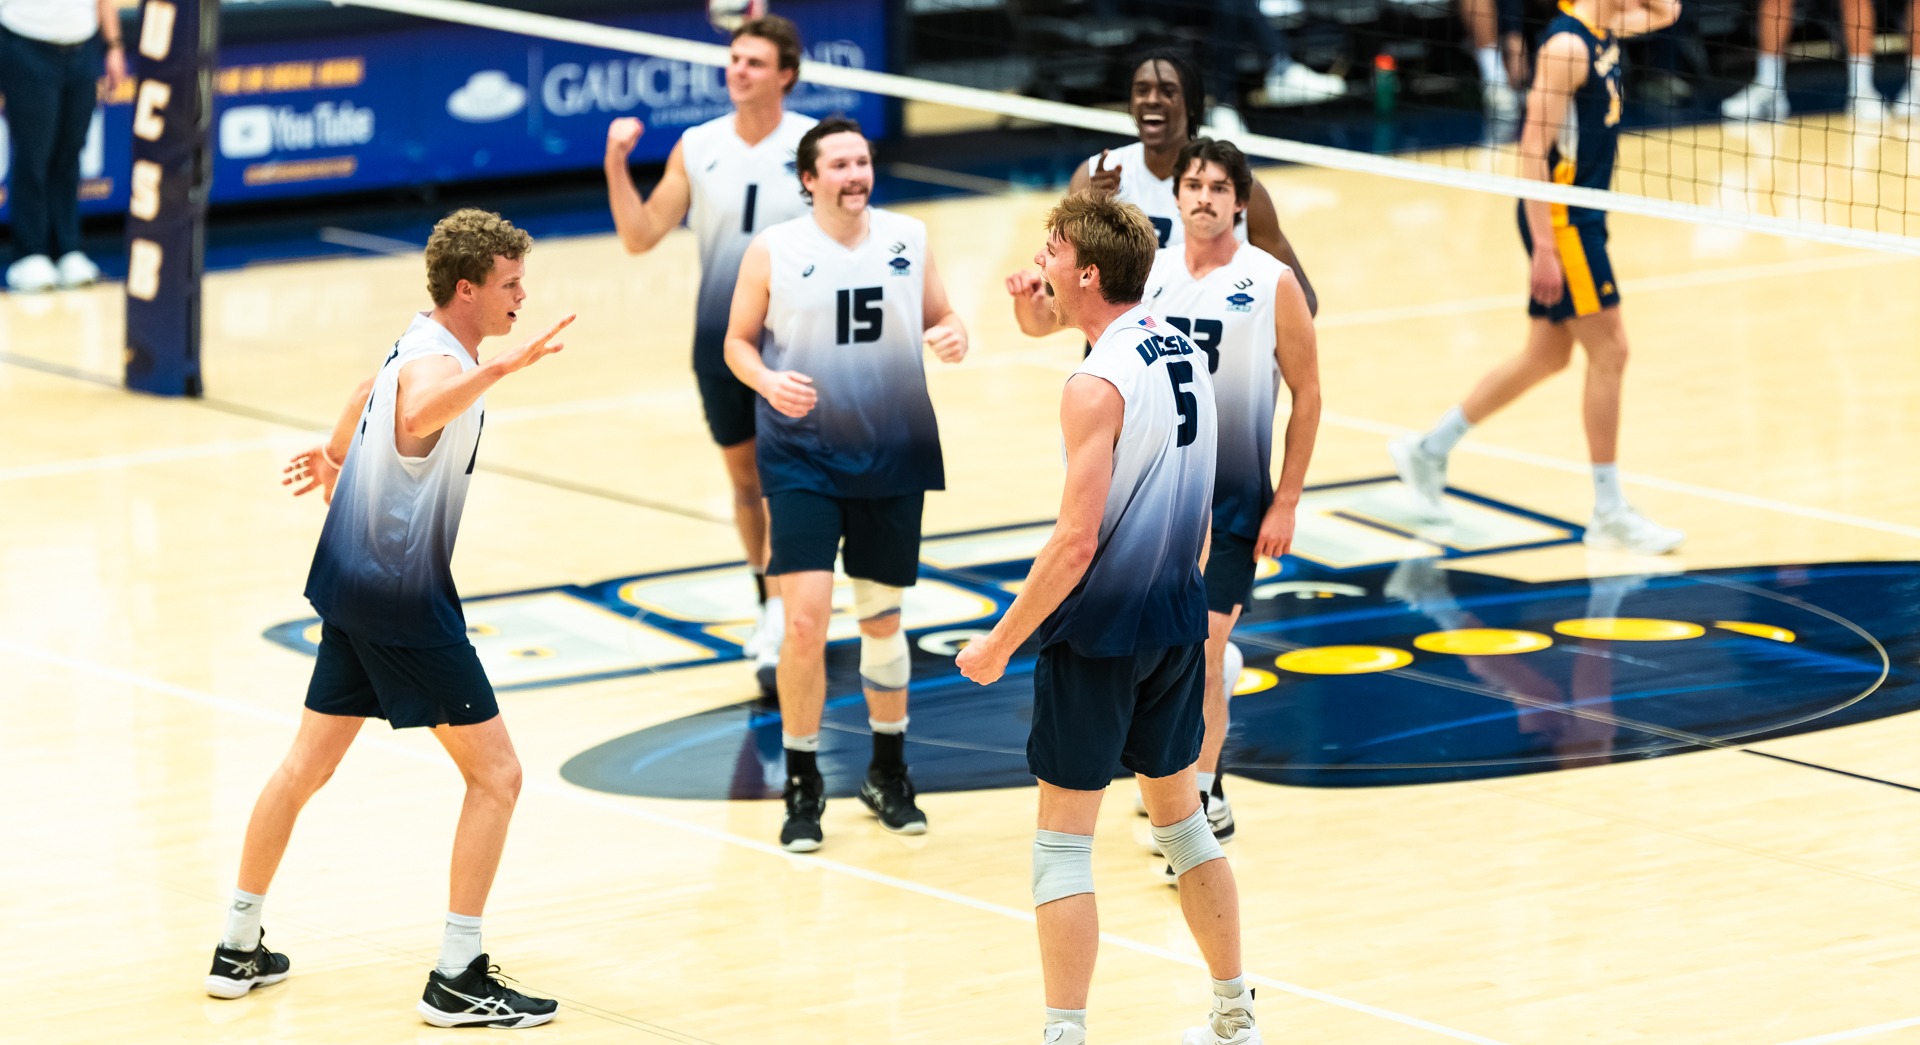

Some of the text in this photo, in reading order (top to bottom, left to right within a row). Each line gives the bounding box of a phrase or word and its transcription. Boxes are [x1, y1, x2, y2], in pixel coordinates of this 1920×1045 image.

[836, 286, 883, 346] 15
[1135, 335, 1194, 367] UCSB
[1166, 360, 1198, 448] 5
